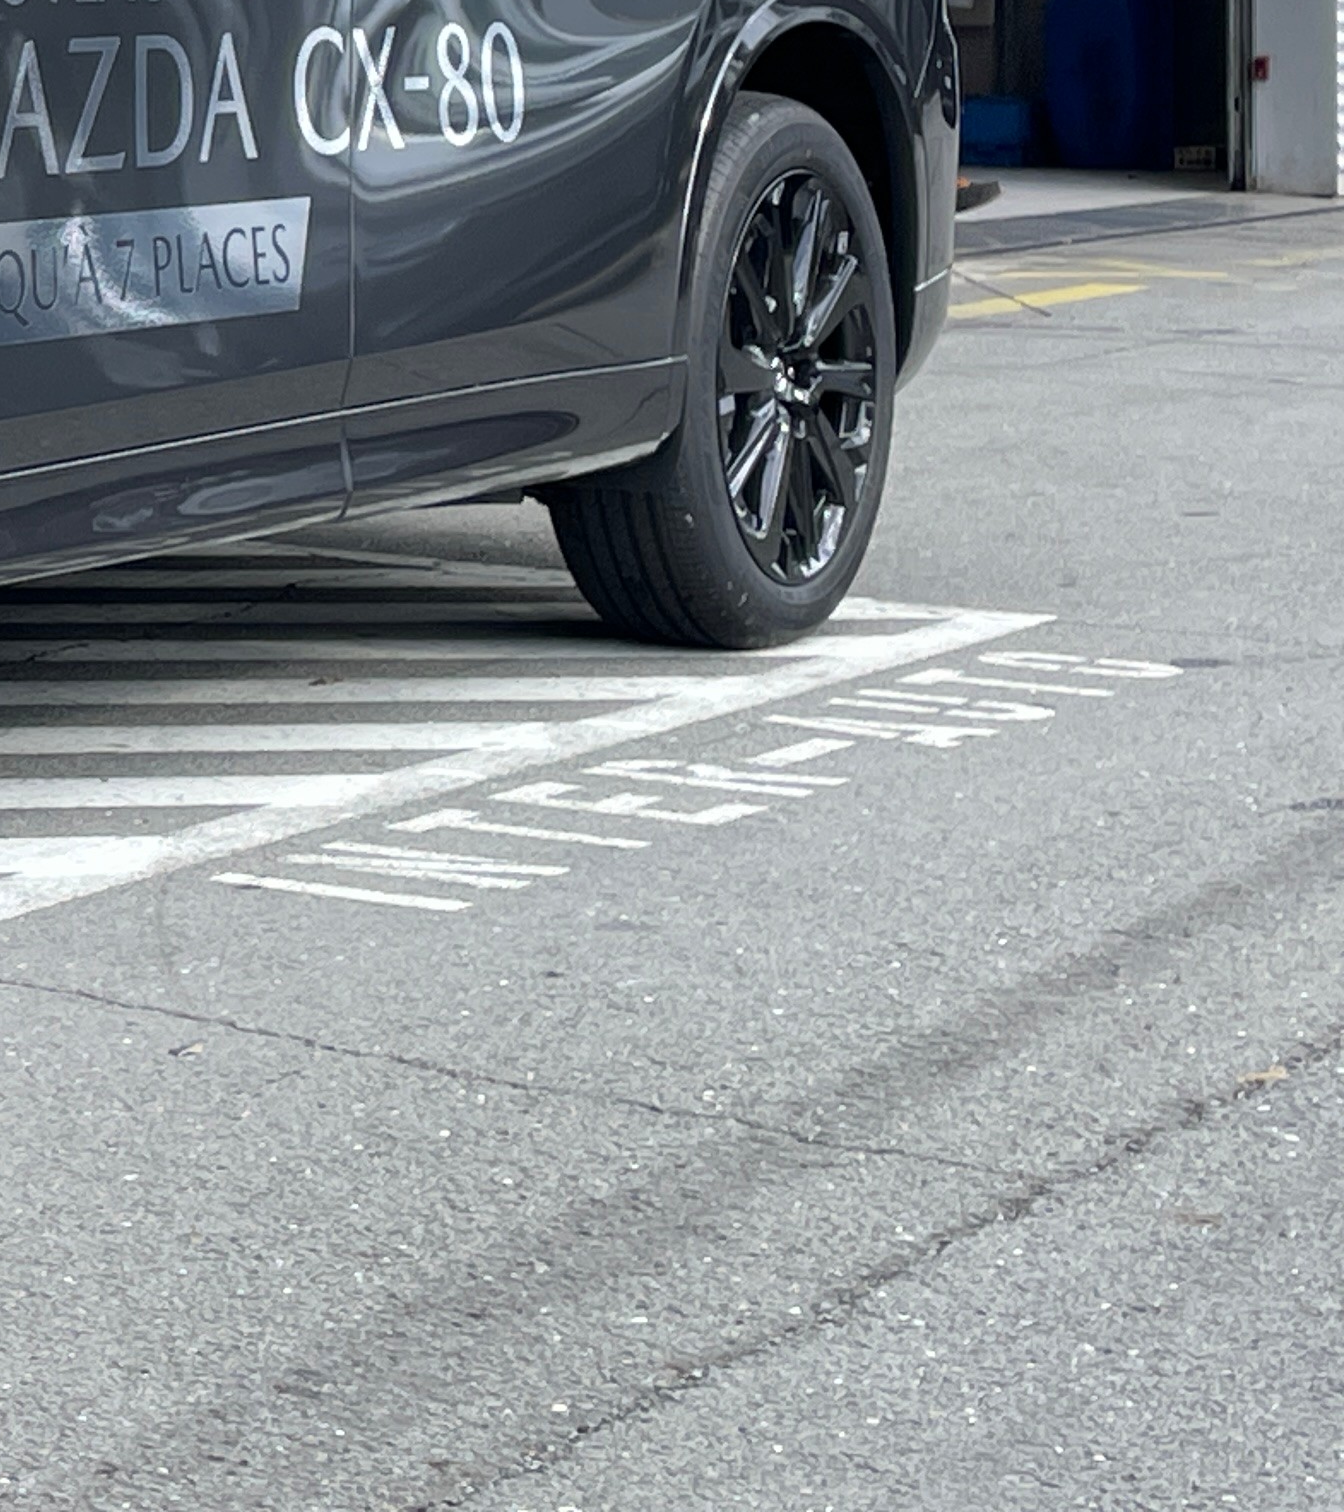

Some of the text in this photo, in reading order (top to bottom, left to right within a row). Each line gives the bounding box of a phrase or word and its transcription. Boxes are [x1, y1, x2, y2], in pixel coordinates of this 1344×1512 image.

[293, 21, 525, 156] CX-80
[115, 238, 135, 301] 7
[152, 223, 291, 297] PLACES
[210, 650, 1184, 912] INTER-AUTO
